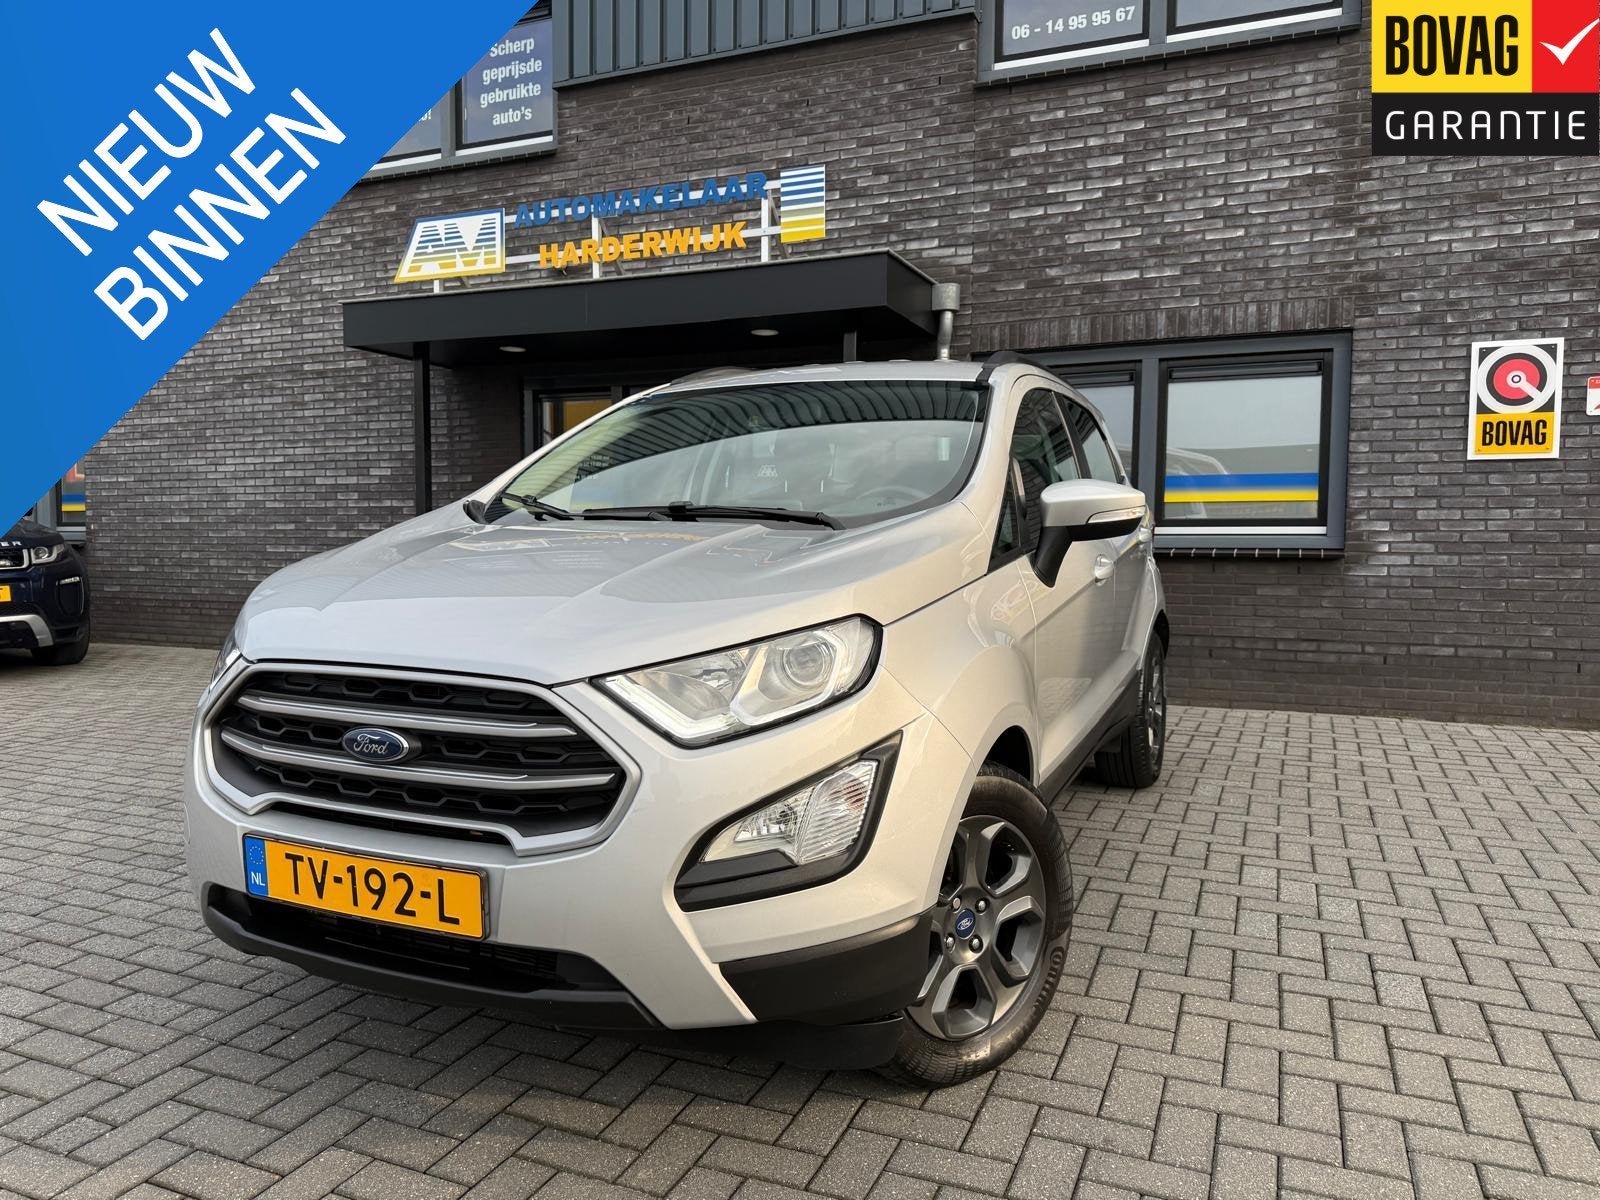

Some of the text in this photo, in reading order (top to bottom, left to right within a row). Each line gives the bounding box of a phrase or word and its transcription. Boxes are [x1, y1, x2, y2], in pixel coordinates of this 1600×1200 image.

[1011, 24, 1030, 40] 06
[1045, 18, 1065, 34] 14
[1068, 14, 1088, 30] 95
[1091, 9, 1111, 26] 95
[1115, 5, 1136, 22] 67
[482, 58, 543, 85] geprijsde
[480, 82, 542, 108] gebruikte
[492, 106, 532, 126] auto's
[513, 171, 769, 229] AUTOMAKELAAR
[407, 217, 497, 273] AM
[538, 221, 747, 268] HARDERWIJK
[1481, 419, 1548, 447] BOVAG
[353, 733, 389, 755] Ford
[251, 872, 266, 887] NL
[285, 852, 461, 926] TV-192-L
